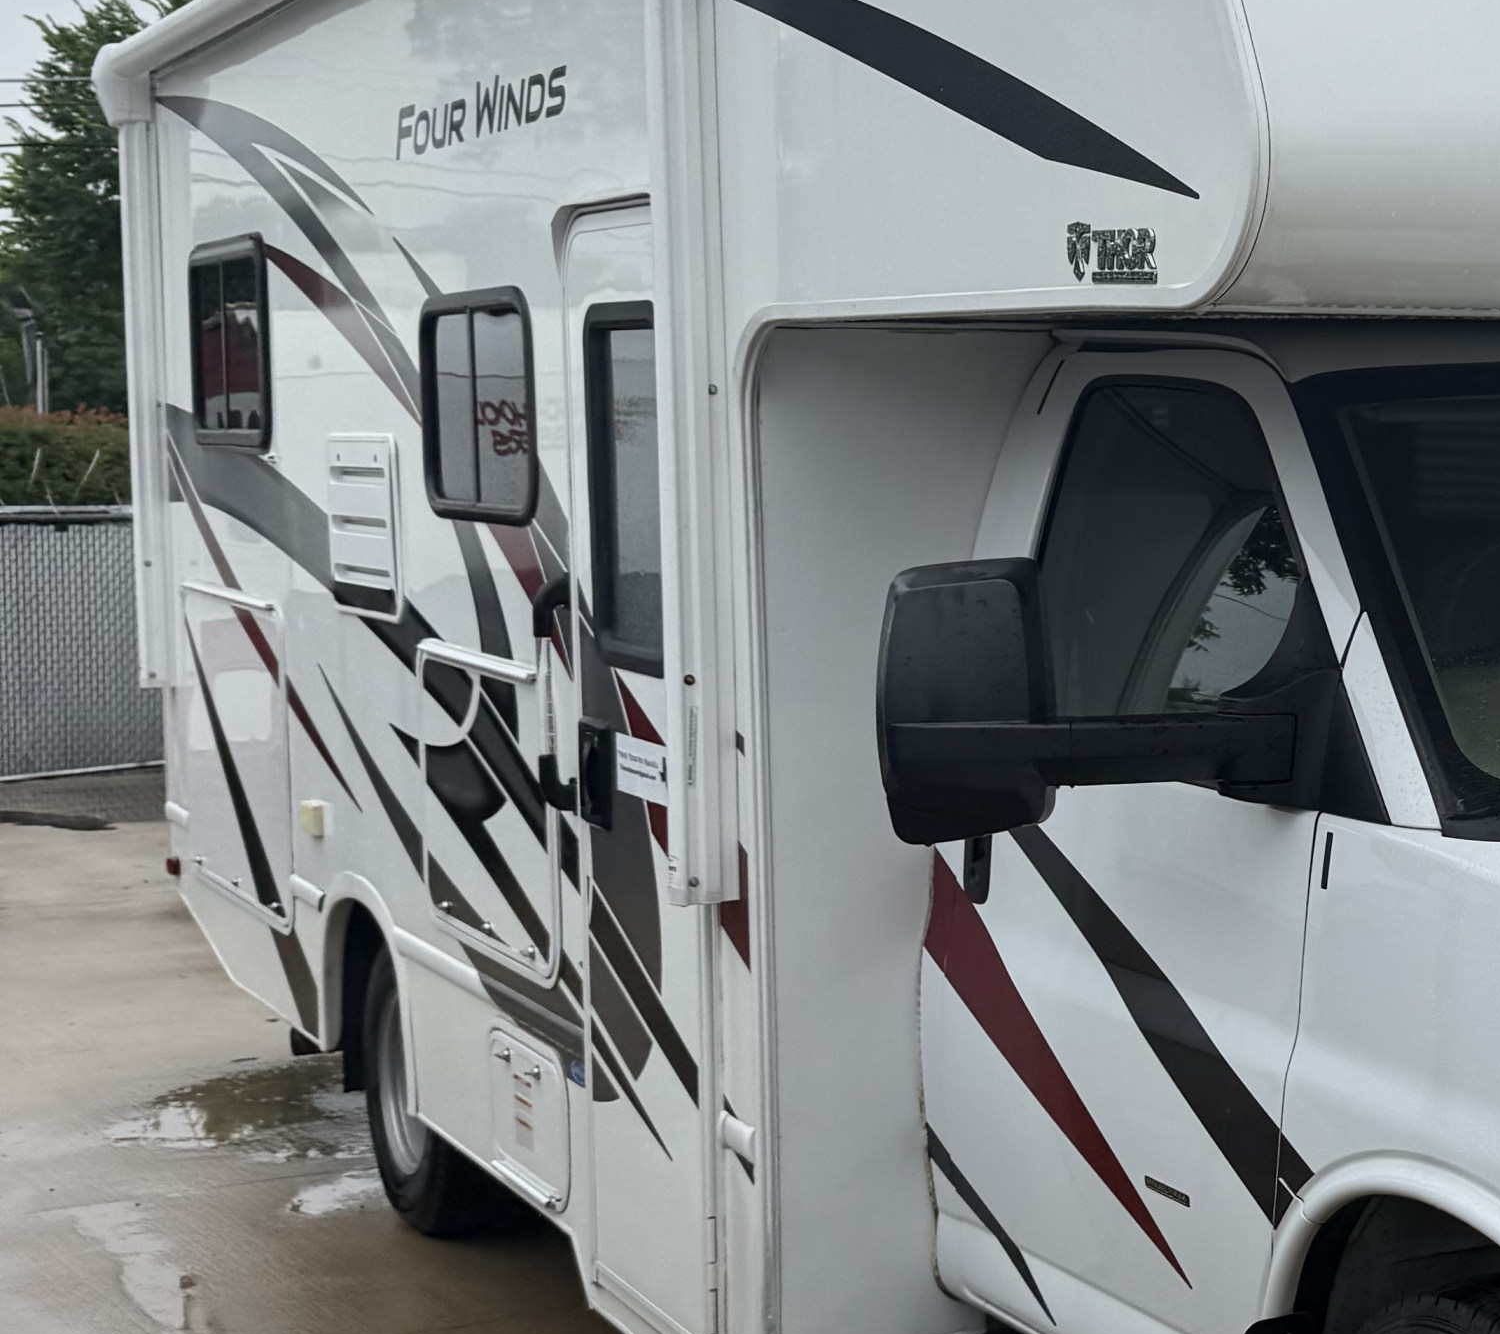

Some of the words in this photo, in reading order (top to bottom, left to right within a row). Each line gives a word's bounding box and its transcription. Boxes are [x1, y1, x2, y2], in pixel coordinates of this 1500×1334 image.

[396, 98, 466, 161] FOUR
[475, 64, 567, 139] WINDS
[1091, 227, 1157, 270] THOR
